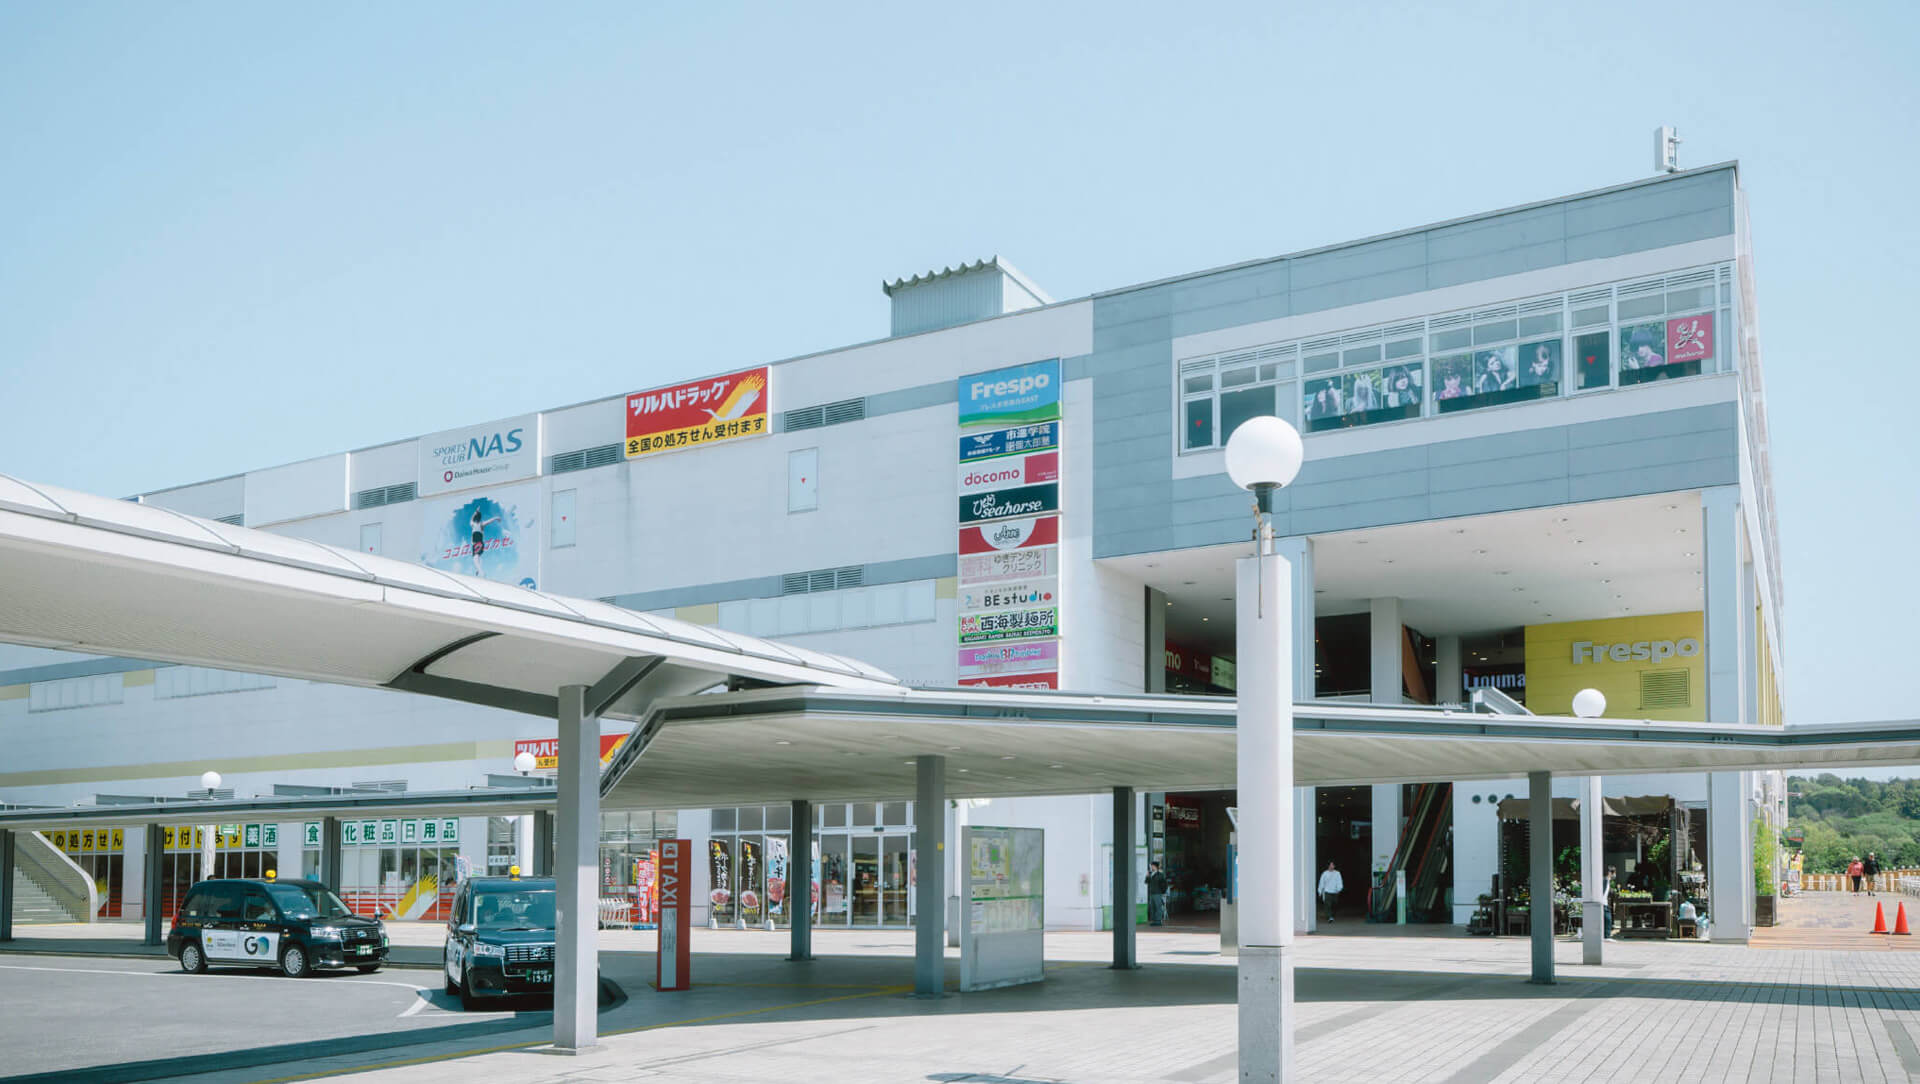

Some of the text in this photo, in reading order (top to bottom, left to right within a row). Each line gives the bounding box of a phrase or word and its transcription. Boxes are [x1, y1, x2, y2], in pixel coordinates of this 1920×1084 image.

[970, 373, 1051, 401] Frespo
[630, 380, 731, 417] ツルハドラッグ
[467, 428, 524, 461] NAS
[628, 417, 765, 454] 全国の処方せん受付ます
[433, 442, 467, 458] SPORTS
[442, 452, 466, 466] CLUB
[964, 469, 1021, 486] docomo
[1002, 559, 1042, 575] クリニック
[984, 594, 1001, 608] BE
[1002, 589, 1053, 606] studio
[980, 610, 1055, 632] 西海製麺所
[1572, 637, 1701, 665] Frespo
[265, 828, 277, 843] 酒
[307, 825, 320, 842] 食
[344, 822, 396, 842] 化粧品
[405, 821, 457, 839] 日用品
[662, 861, 678, 906] TAXI
